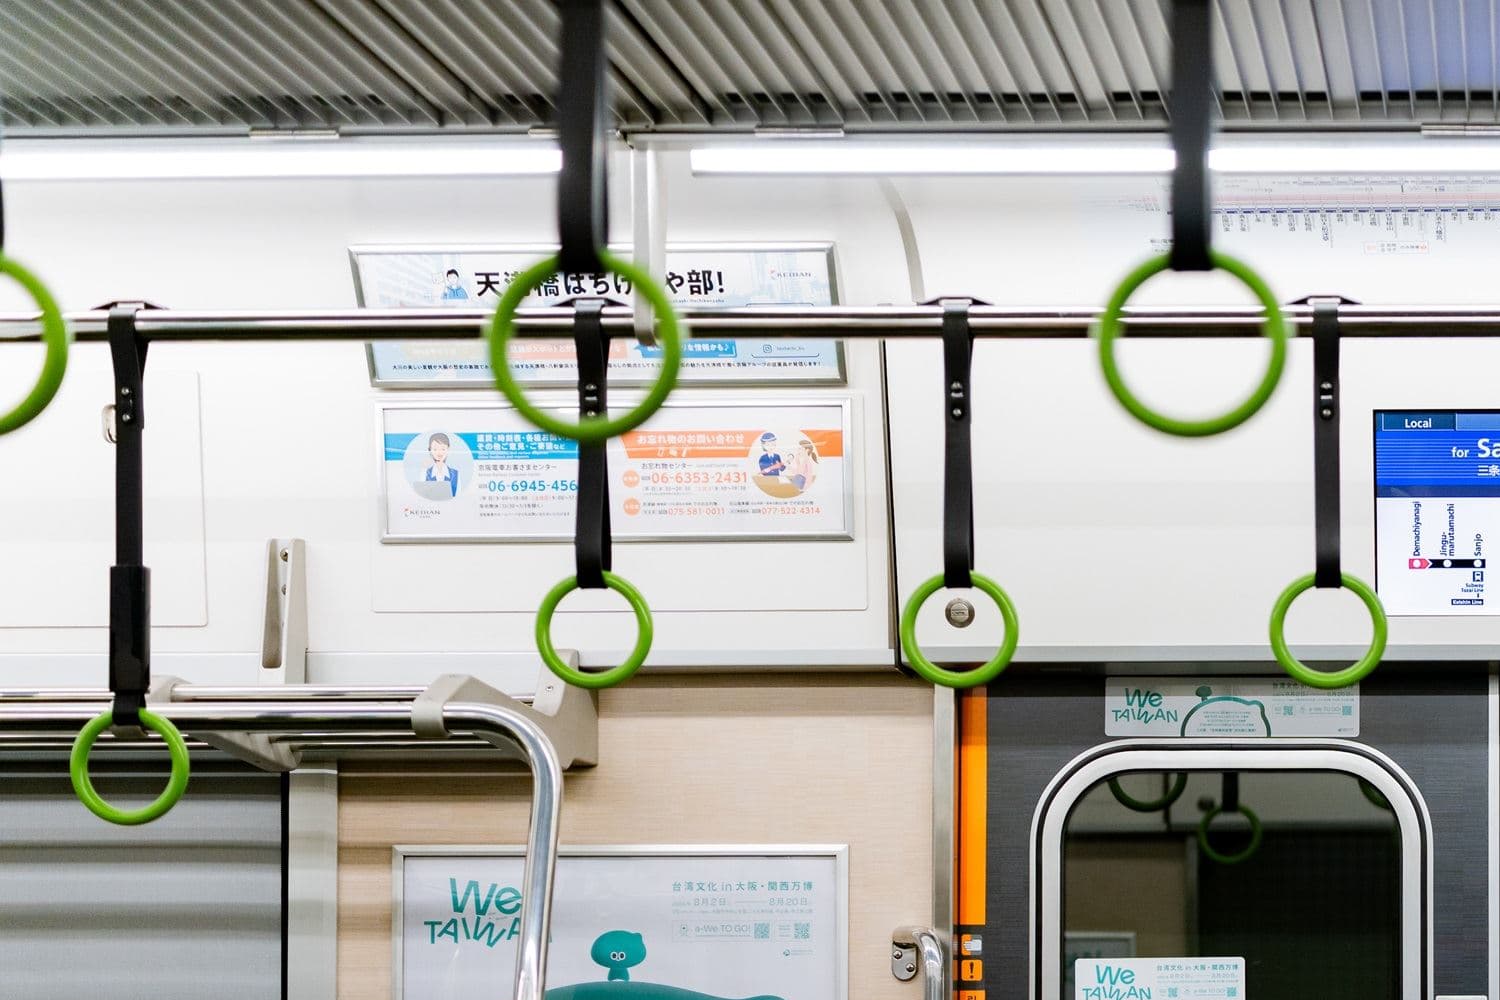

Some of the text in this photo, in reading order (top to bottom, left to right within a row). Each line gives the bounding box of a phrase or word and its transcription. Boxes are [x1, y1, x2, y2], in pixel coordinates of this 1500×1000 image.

[475, 270, 725, 297] 天橋はちけや部!
[1404, 418, 1432, 429] Local
[1451, 446, 1470, 458] for
[651, 471, 748, 484] 06-6353-2431
[1477, 465, 1500, 476] 三条
[488, 479, 578, 492] 06-6945-456
[1412, 501, 1422, 557] Demachiyanagi
[1446, 503, 1455, 557] marutamachi
[1440, 531, 1449, 556] Jingu-
[1473, 533, 1484, 556] Sanjo
[1124, 687, 1163, 709] We
[1111, 706, 1178, 725] TAIWAN
[449, 877, 522, 916] We
[672, 881, 813, 892] 台湾文化 in 大阪・関西万博
[424, 915, 552, 948] TAIWA
[720, 924, 732, 933] TO
[1095, 965, 1135, 985] We
